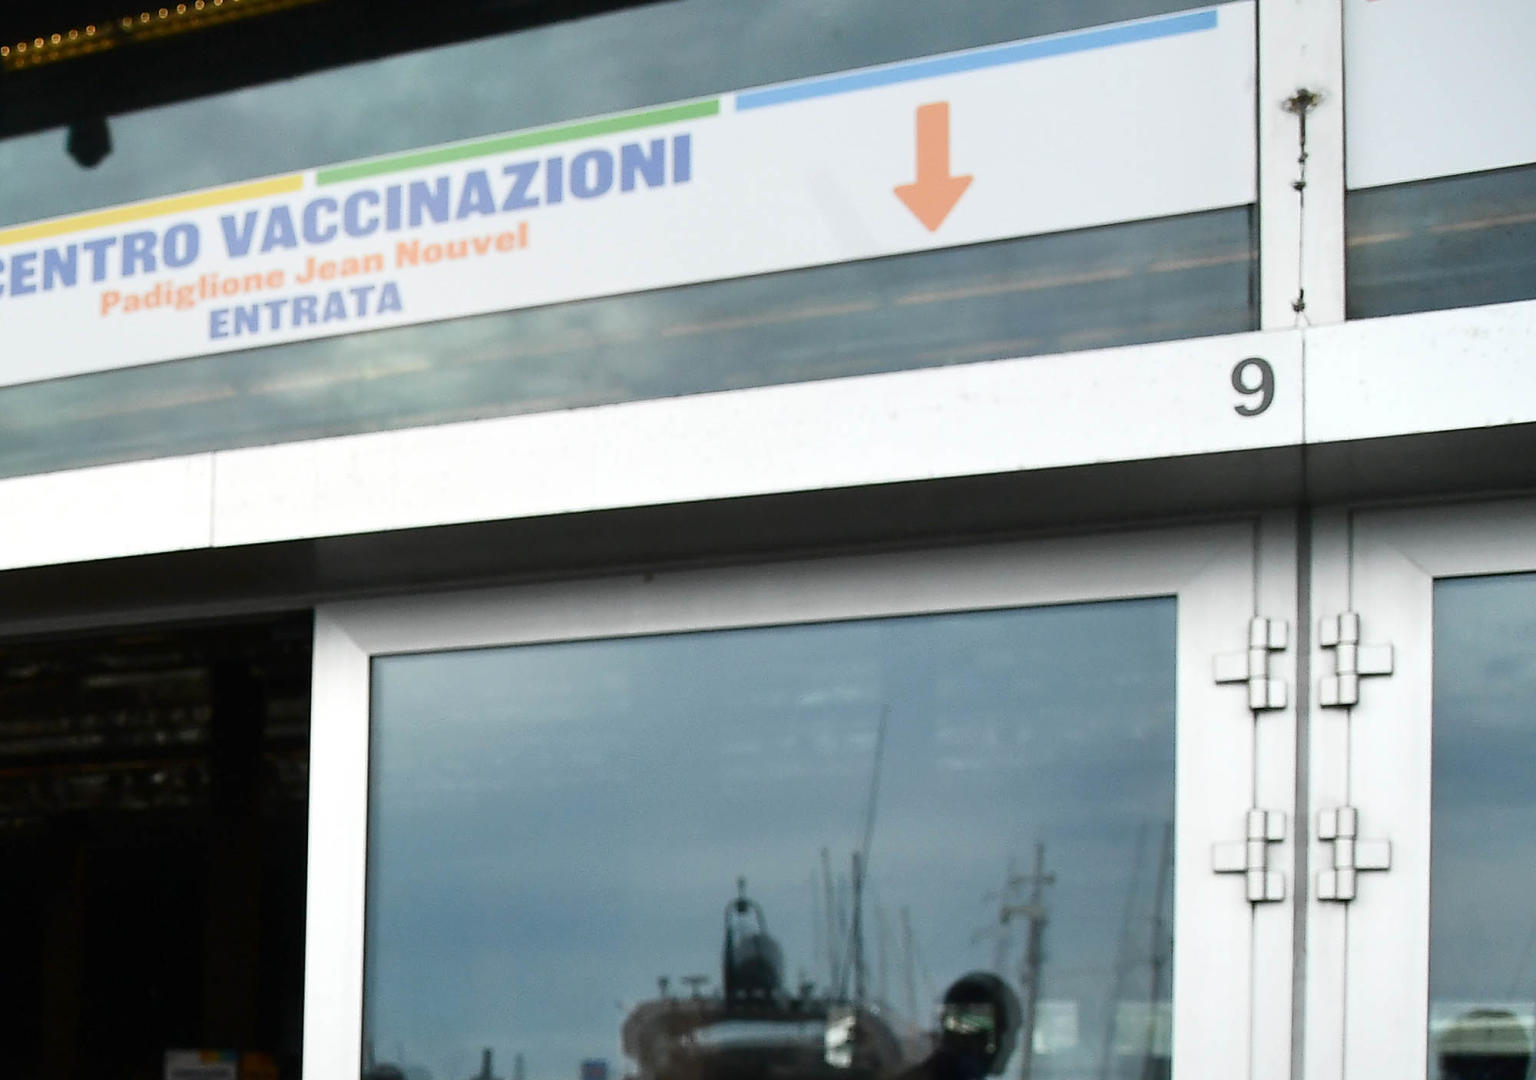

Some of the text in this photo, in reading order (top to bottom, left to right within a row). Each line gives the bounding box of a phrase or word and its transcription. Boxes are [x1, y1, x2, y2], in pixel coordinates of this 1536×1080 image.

[220, 132, 693, 259] VACCINAZIONI
[99, 221, 530, 317] Padiglione Jean Nouvel
[208, 280, 404, 341] ENTRATA
[1231, 357, 1275, 417] 9
